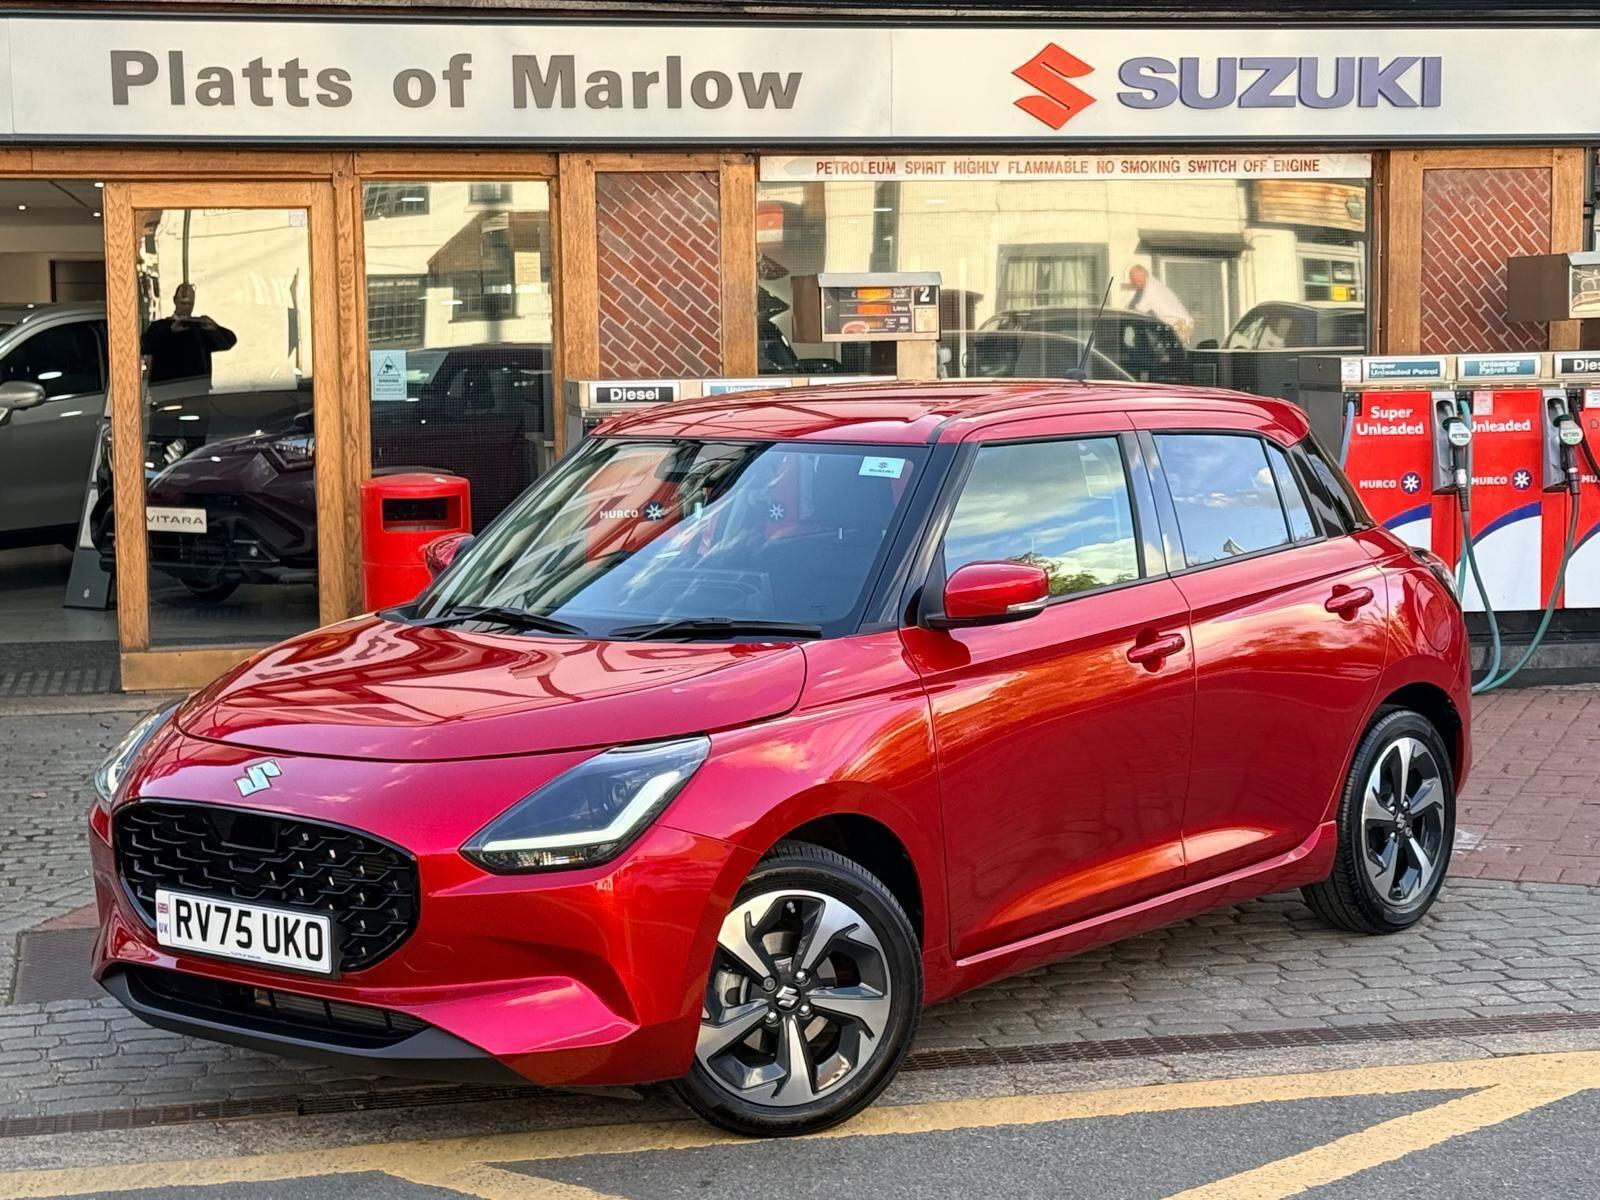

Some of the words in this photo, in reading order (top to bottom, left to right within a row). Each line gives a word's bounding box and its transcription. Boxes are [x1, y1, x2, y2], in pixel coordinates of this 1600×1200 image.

[110, 50, 353, 108] Platts
[392, 53, 472, 109] of
[512, 54, 804, 110] Marlow
[1117, 56, 1442, 109] SUZUKI
[816, 160, 896, 175] PETROLEUM
[905, 160, 946, 175] SPIRIT
[953, 160, 999, 175] HIGHLY
[1008, 160, 1088, 175] FLAMMABLE
[1096, 160, 1115, 174] NO
[1121, 160, 1180, 173] SMOKING
[1188, 159, 1236, 173] SWITCH
[1243, 159, 1267, 173] OFF
[1273, 159, 1320, 172] ENGINE
[920, 286, 930, 302] 2
[1370, 363, 1396, 371] Super
[1573, 359, 1600, 371] Die
[1370, 368, 1411, 377] Unleaded
[1412, 368, 1438, 376] Petrol
[609, 388, 659, 400] Diesel
[1370, 406, 1414, 420] Super
[1356, 422, 1425, 436] Unleaded
[1359, 479, 1396, 489] MURCO
[1471, 476, 1507, 486] MURCO
[146, 515, 203, 525] VITARA
[600, 509, 638, 519] MURCO
[159, 922, 168, 934] UK
[175, 899, 252, 950] RV75
[263, 913, 323, 962] UKO
